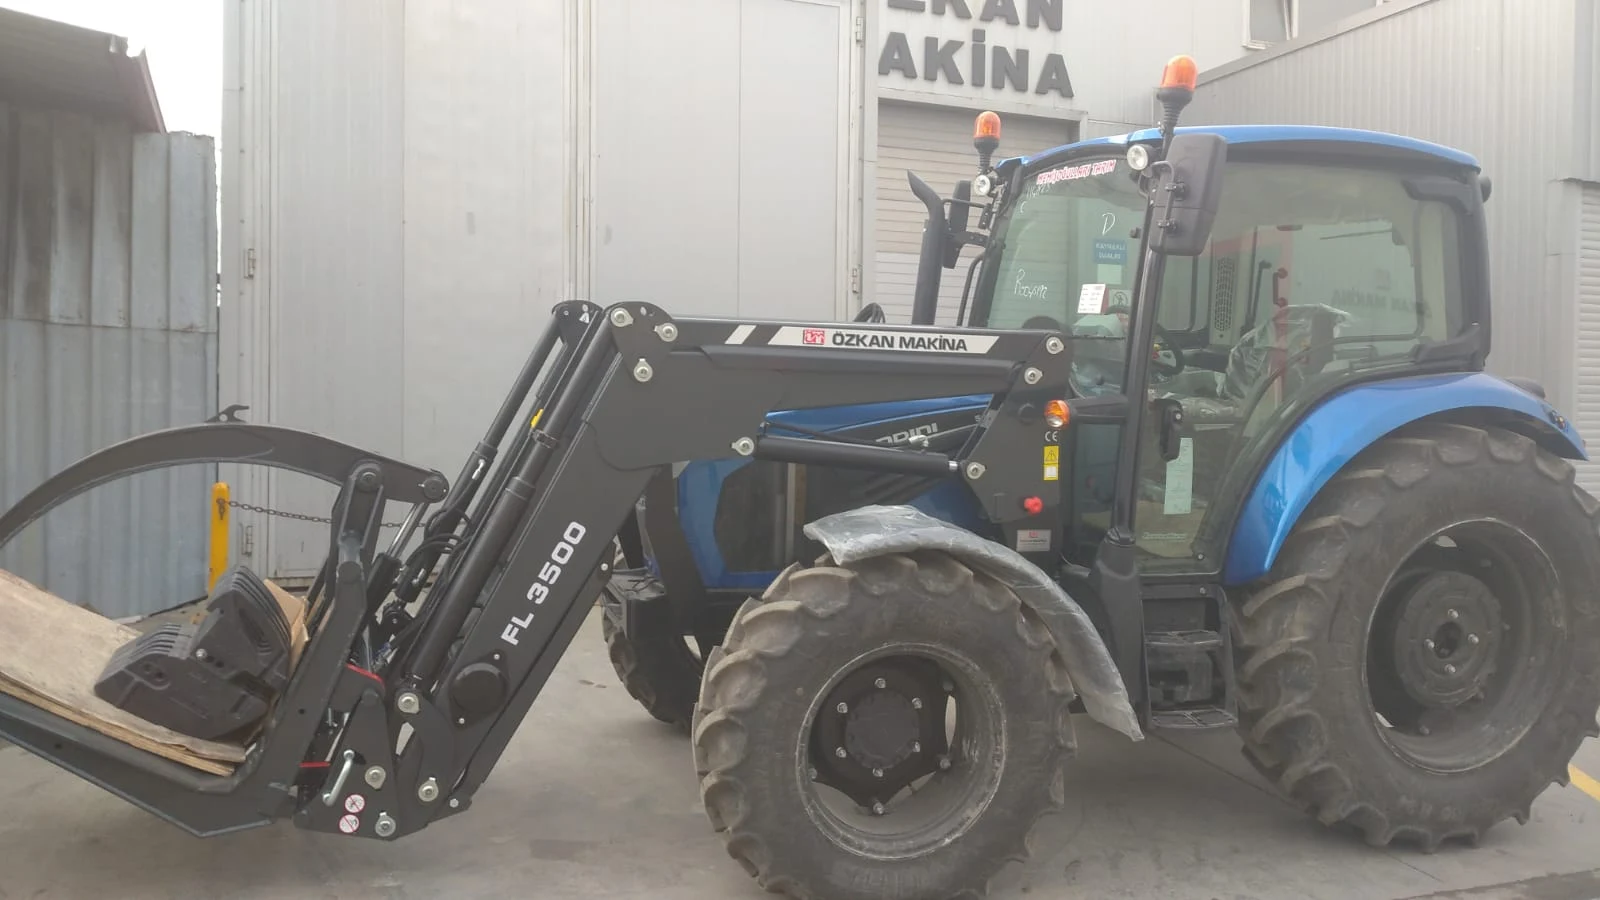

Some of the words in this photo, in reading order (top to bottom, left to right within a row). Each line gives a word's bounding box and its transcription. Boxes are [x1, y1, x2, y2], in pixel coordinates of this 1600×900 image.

[832, 331, 895, 348] ÖZKAN
[899, 335, 968, 352] MAKİNA
[501, 613, 535, 646] FL
[526, 521, 586, 605] 3500
